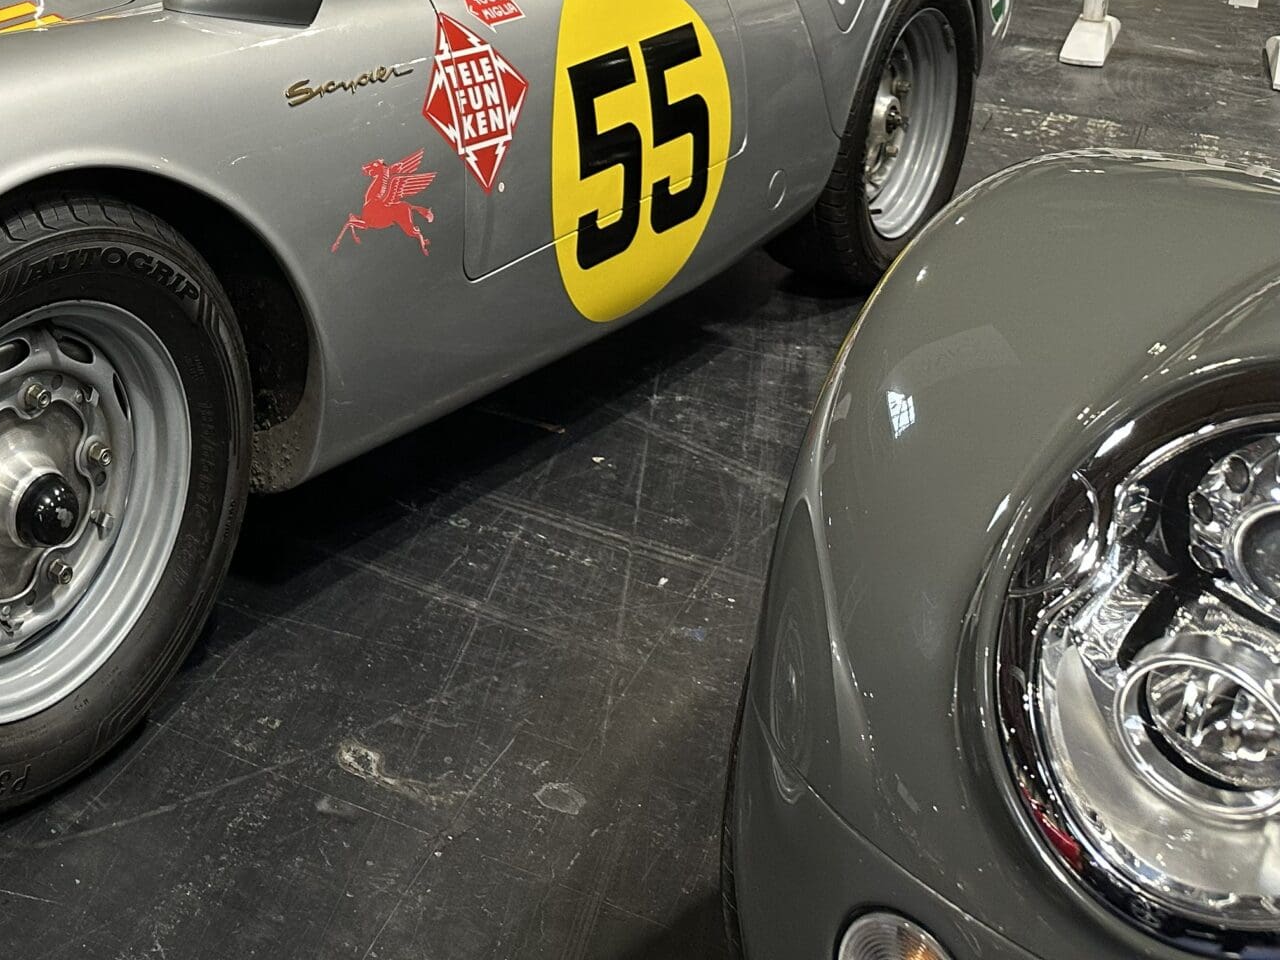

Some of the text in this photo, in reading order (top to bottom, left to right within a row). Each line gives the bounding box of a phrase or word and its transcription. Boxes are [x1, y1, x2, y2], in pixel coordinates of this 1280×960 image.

[481, 2, 519, 20] MIGLIA
[285, 65, 414, 108] Spyder
[445, 55, 496, 89] TELE
[456, 84, 501, 115] FUN
[461, 110, 505, 141] KEN
[566, 21, 711, 271] 55
[20, 245, 202, 304] AUTOGRIP
